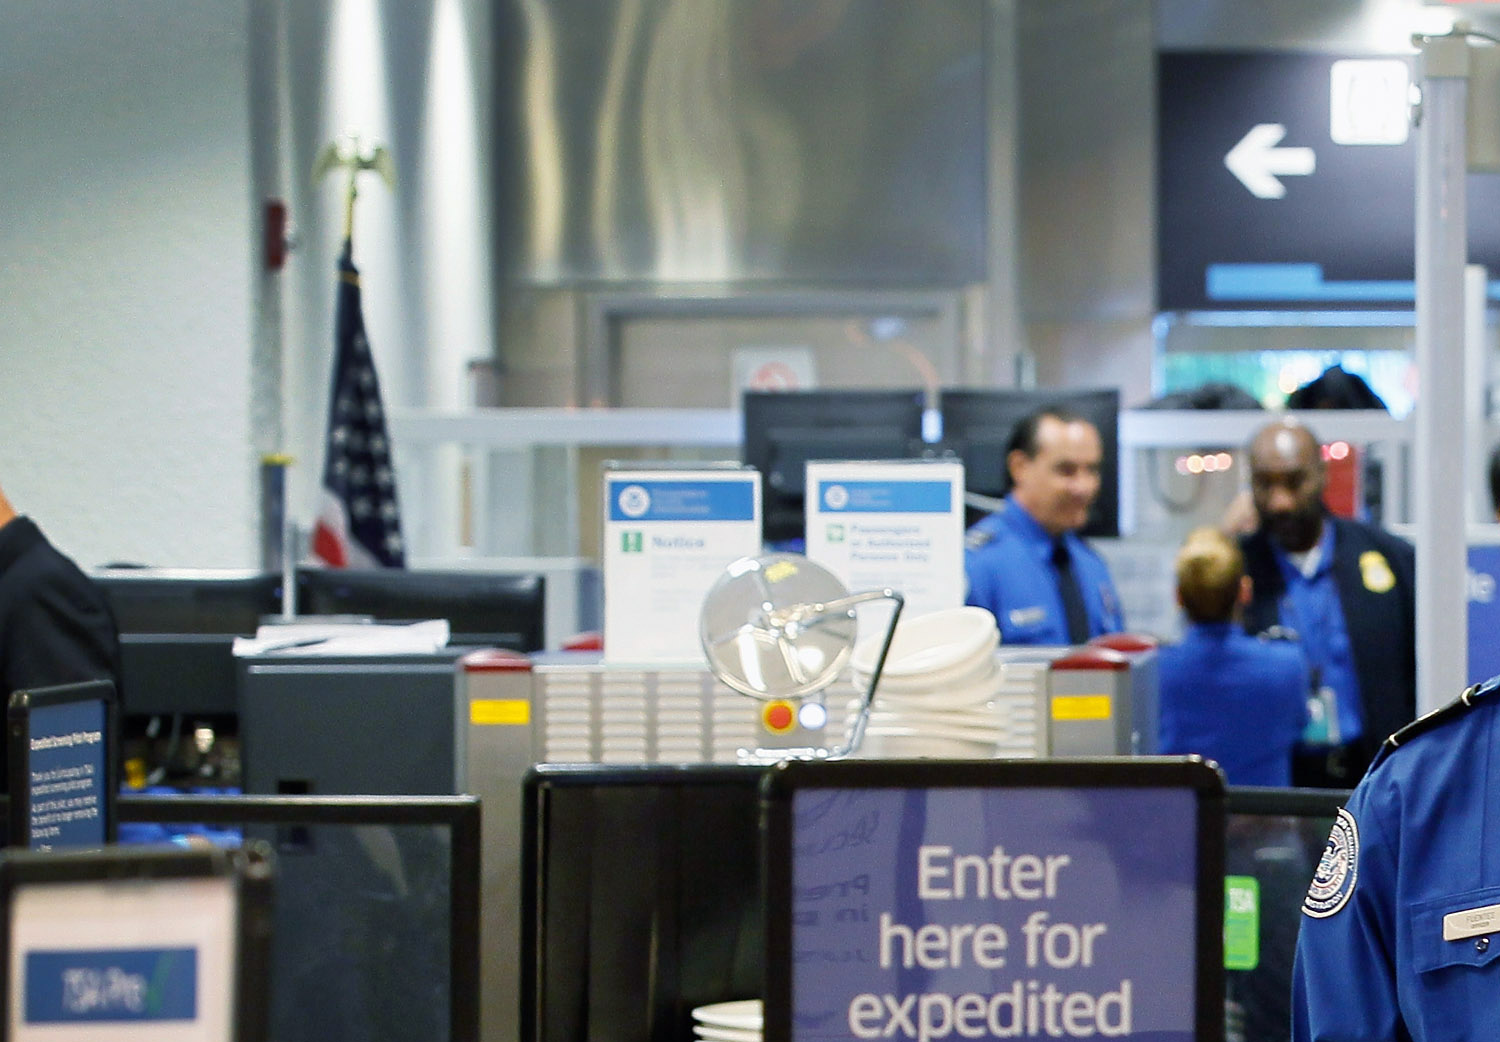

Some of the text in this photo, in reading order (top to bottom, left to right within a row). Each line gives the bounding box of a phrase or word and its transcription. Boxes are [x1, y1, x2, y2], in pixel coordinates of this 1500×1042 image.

[918, 846, 1071, 900] Enter
[879, 910, 1107, 969] here for
